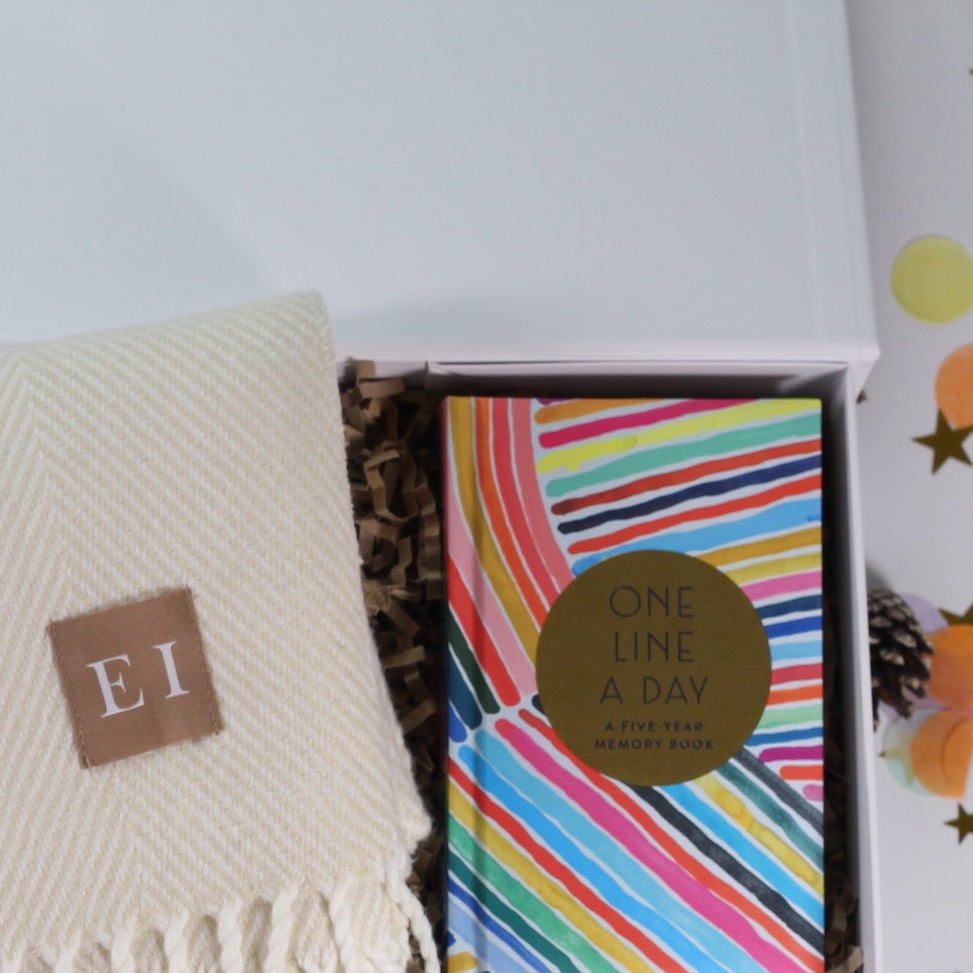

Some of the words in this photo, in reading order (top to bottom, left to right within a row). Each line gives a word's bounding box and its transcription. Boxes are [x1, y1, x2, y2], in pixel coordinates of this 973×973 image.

[610, 585, 695, 618] ONE
[614, 631, 695, 663] LINE
[86, 653, 145, 719] E
[599, 676, 624, 705] A
[643, 676, 709, 705] DAY
[605, 721, 615, 732] A
[595, 738, 663, 750] MEMORY
[669, 738, 715, 750] BOOK
